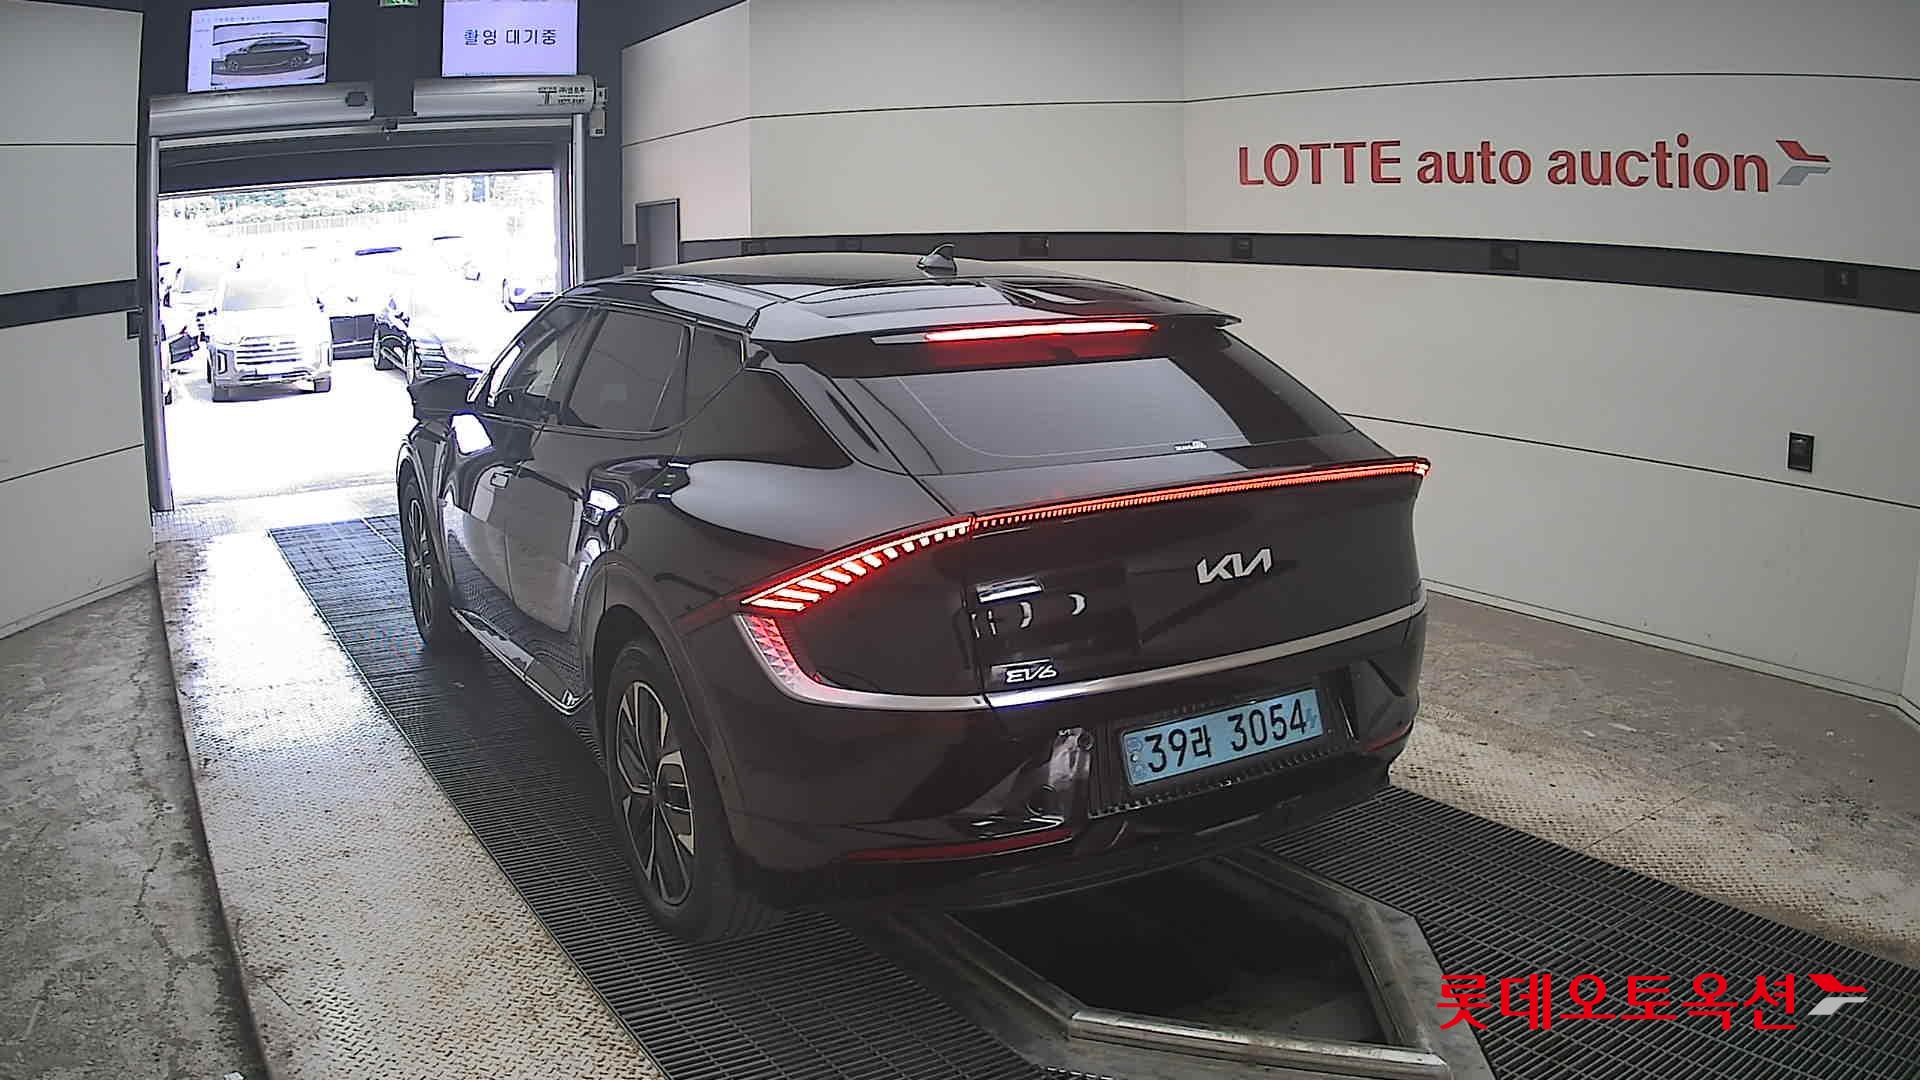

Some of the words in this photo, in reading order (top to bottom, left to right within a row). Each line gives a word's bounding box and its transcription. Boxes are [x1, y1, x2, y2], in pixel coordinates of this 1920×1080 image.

[505, 28, 557, 46] 대기중
[1239, 140, 1401, 187] LOTTE
[1417, 141, 1532, 186] auto
[1547, 133, 1770, 193] auction
[1006, 663, 1057, 684] EV6
[1144, 724, 1212, 773] 39라
[1227, 698, 1307, 752] 3054
